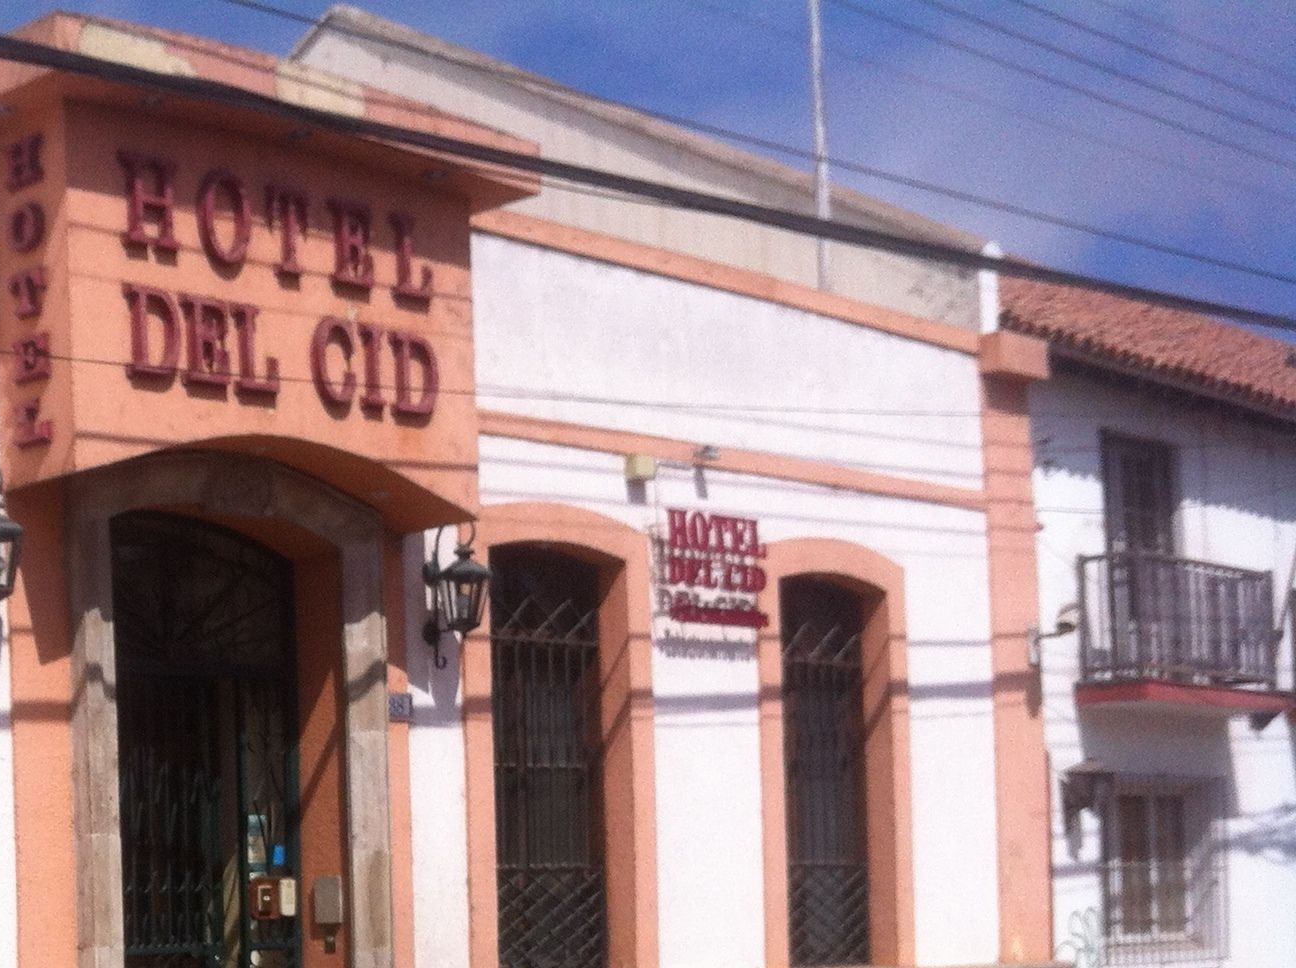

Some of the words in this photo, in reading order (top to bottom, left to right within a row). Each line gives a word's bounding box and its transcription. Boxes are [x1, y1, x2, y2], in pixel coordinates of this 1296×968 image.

[6, 132, 52, 449] HOTEL
[116, 148, 435, 306] HOTEL
[122, 282, 280, 398] DEL
[310, 314, 440, 417] CID
[667, 508, 768, 559] HOTEL
